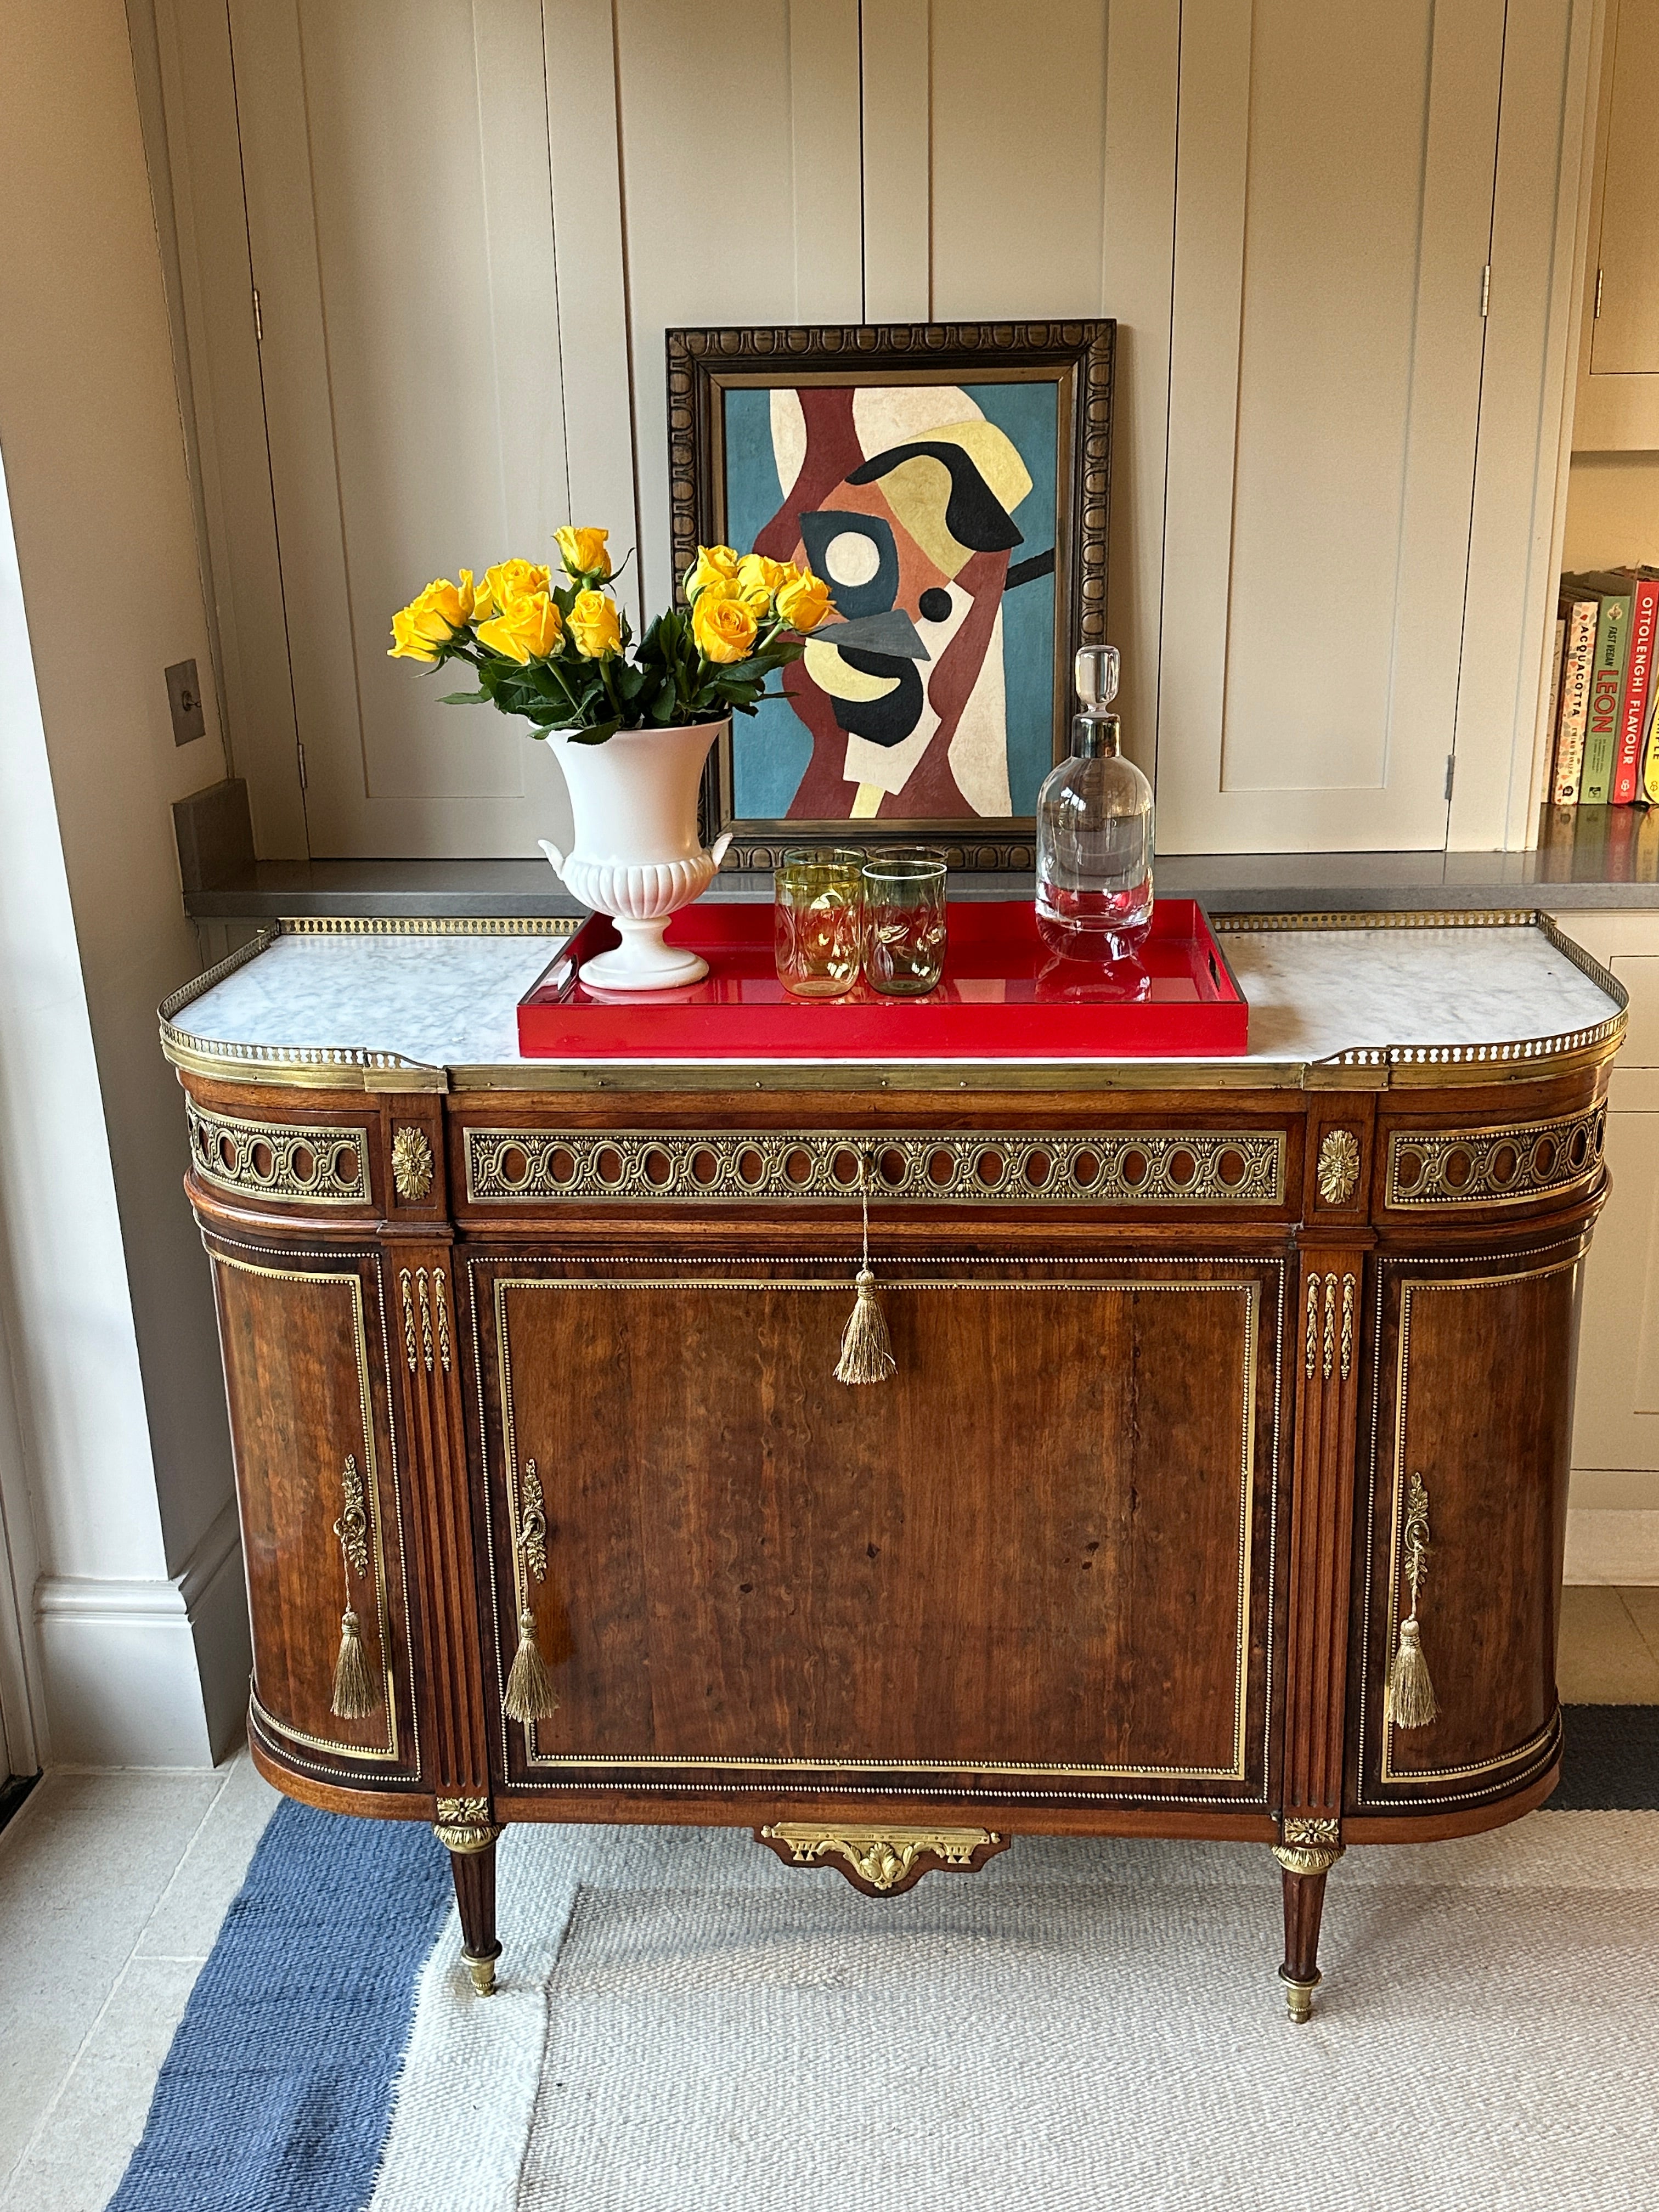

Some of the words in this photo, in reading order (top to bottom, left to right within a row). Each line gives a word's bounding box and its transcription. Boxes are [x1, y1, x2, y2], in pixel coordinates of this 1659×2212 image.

[1605, 646, 1617, 667] VEGAN
[1607, 627, 1617, 645] FAST
[1632, 597, 1654, 692] OTTOLENGHI
[1572, 626, 1589, 716] ACQUACOTTA
[1593, 670, 1619, 732] LEON
[1622, 700, 1640, 765] FLAVOUR
